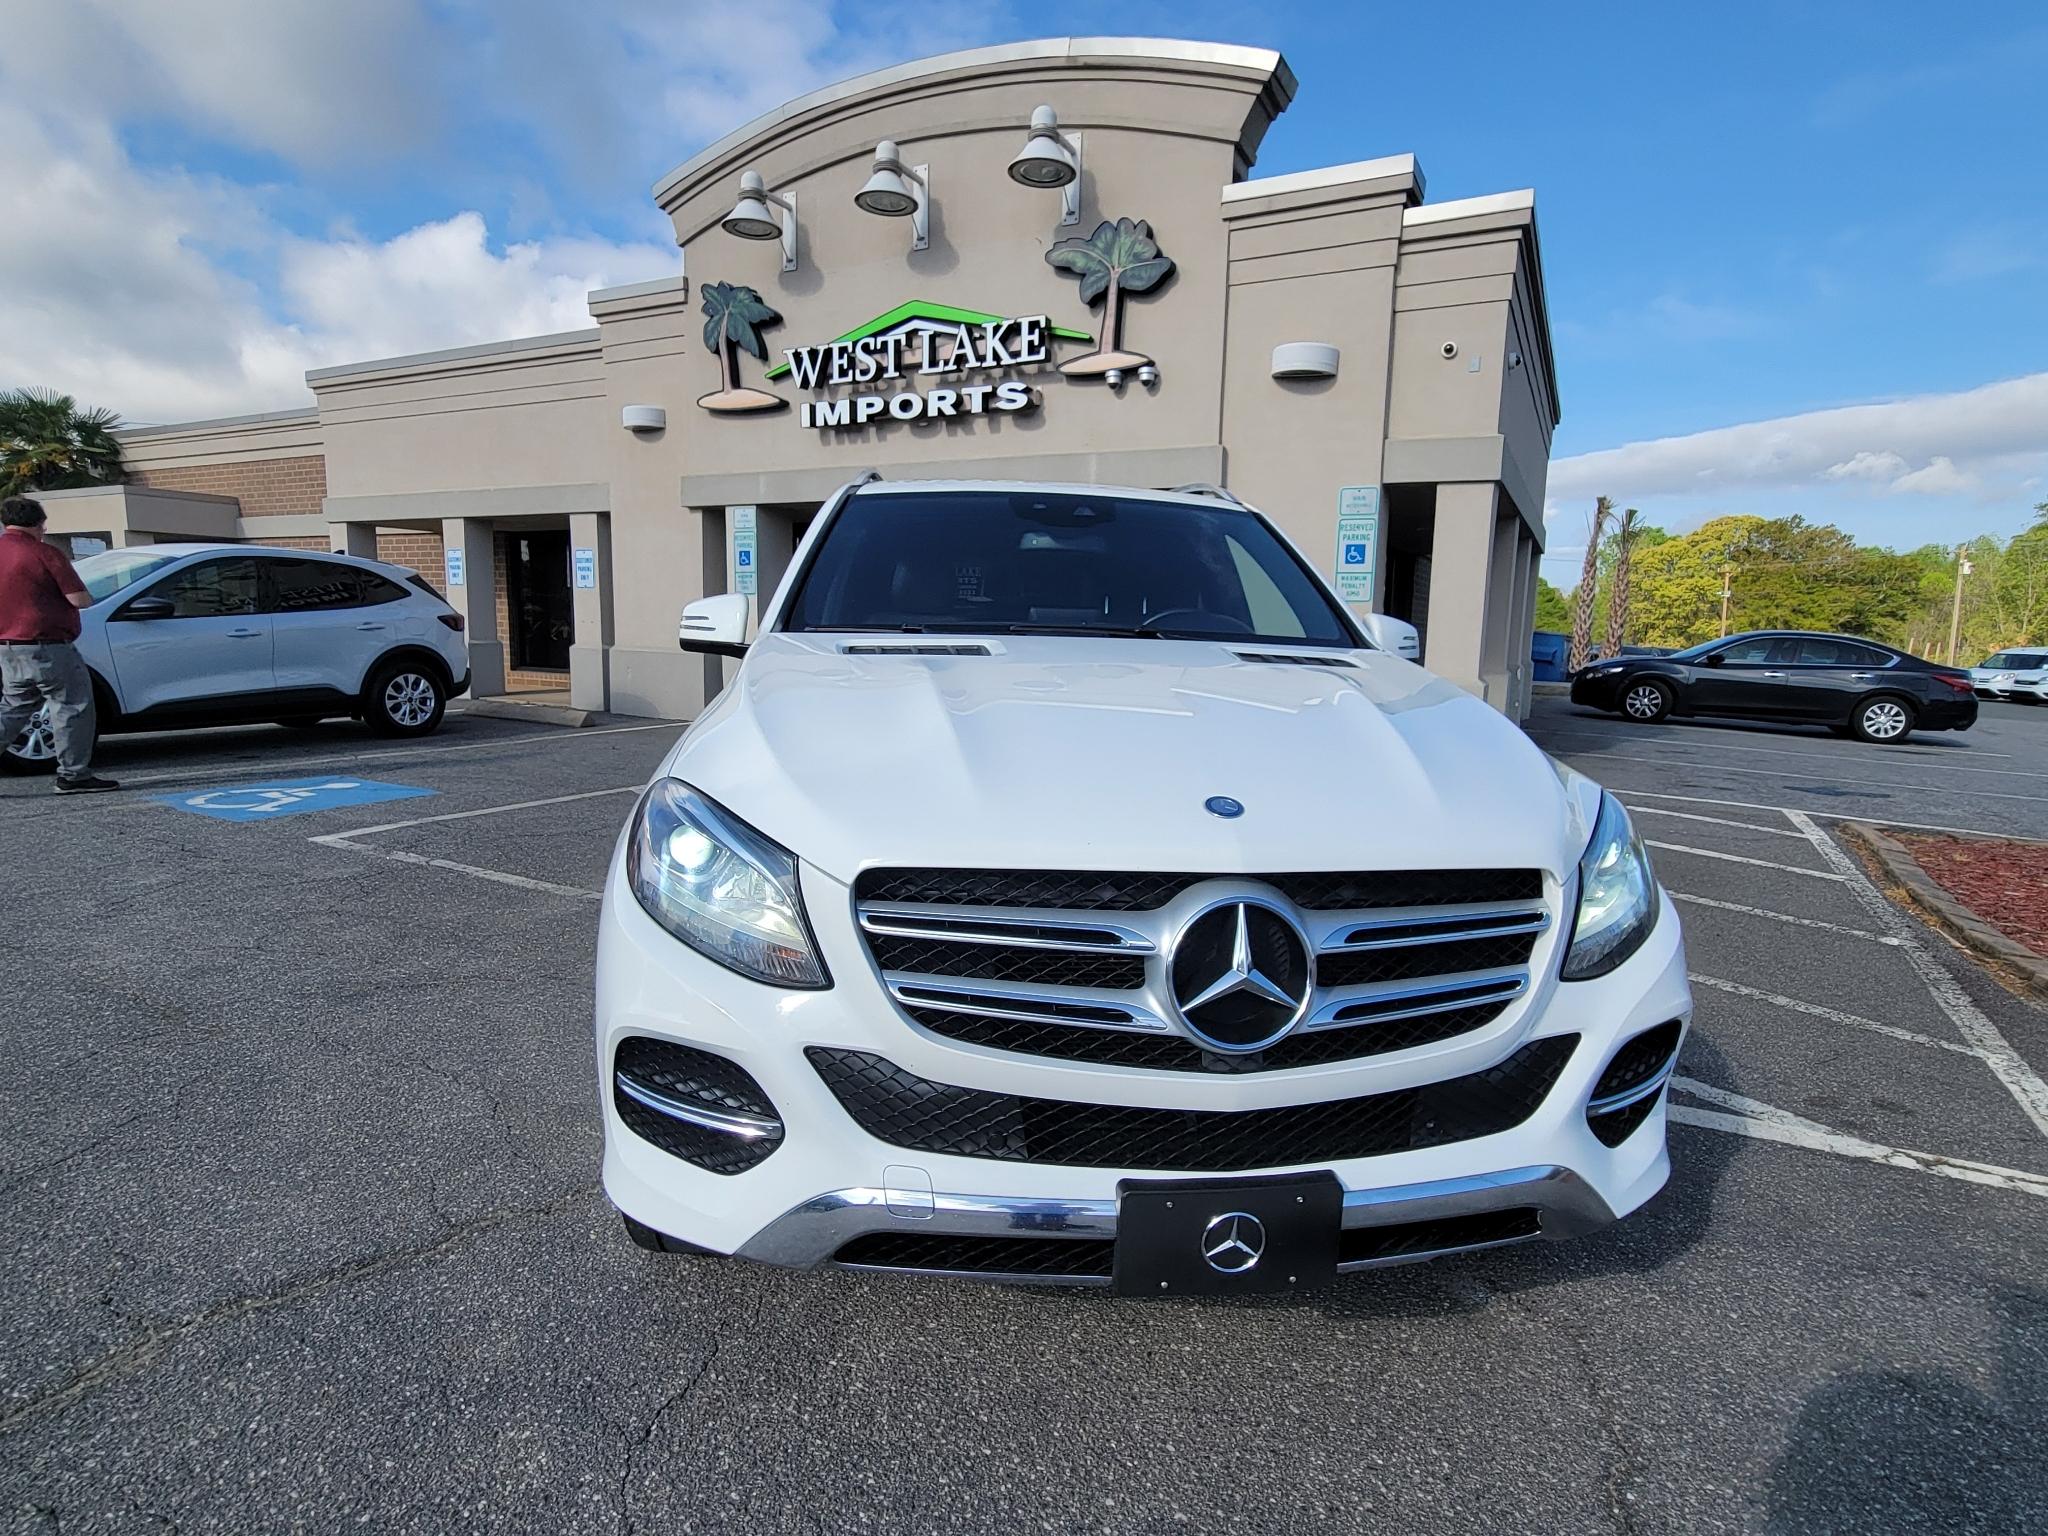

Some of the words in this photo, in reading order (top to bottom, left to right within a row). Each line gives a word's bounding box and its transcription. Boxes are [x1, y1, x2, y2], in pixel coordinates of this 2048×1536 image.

[782, 332, 907, 389] WEST
[917, 314, 1047, 375] LAKE
[800, 381, 1030, 428] IMPORTS
[1340, 523, 1374, 532] RESERVED
[1342, 533, 1371, 541] PARKING
